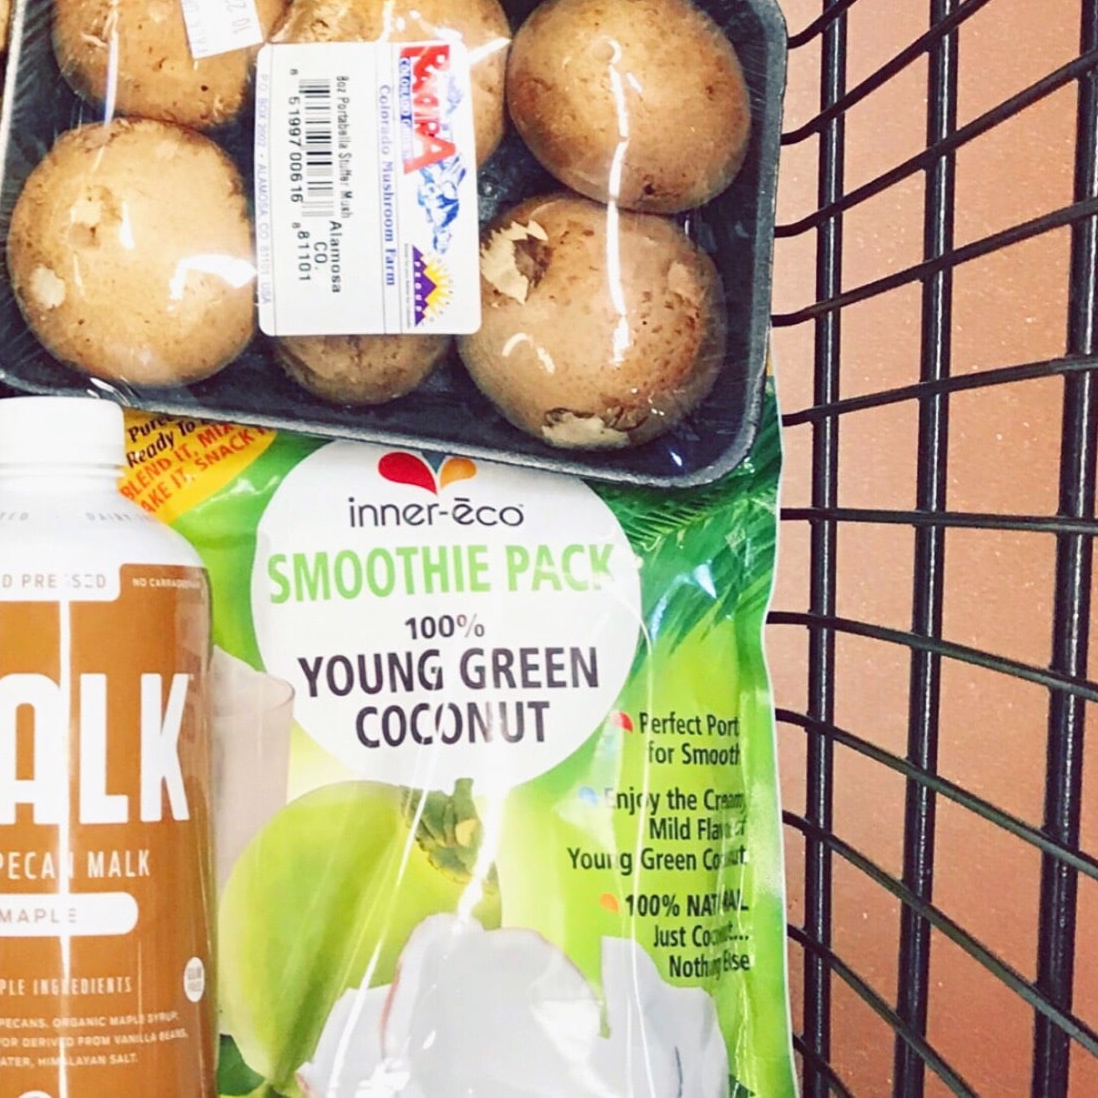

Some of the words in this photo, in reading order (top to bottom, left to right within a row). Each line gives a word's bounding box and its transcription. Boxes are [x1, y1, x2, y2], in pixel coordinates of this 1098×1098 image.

[336, 76, 349, 94] 8oz
[257, 97, 269, 118] BOX
[379, 84, 392, 156] Colorado
[337, 95, 351, 150] Portabella
[289, 151, 304, 203] 00616
[381, 159, 396, 243] Mushroom
[298, 230, 311, 282] 81101
[329, 220, 342, 293] Alamosa
[384, 249, 397, 287] Farm
[260, 280, 272, 306] USA
[414, 260, 423, 313] PROUD
[126, 430, 175, 468] Ready
[176, 419, 197, 437] To
[119, 457, 172, 501] BLEND
[139, 480, 173, 513] AKE
[193, 427, 256, 472] SNACK
[21, 573, 107, 589] PRESED
[132, 577, 147, 588] NO
[266, 541, 493, 606] SMOOTHIE
[504, 540, 616, 593] PACK
[404, 612, 486, 641] 100%
[297, 648, 445, 699] YOUNG
[459, 645, 601, 690] GREEN
[354, 699, 551, 749] COCONUT
[639, 711, 702, 736] Perfect
[648, 743, 676, 765] for
[604, 787, 661, 815] Enjoy
[666, 787, 698, 811] the
[649, 817, 691, 841] Mild
[87, 849, 151, 878] MALK
[567, 847, 633, 876] Young
[640, 848, 697, 871] Green
[625, 894, 680, 917] 100%
[653, 925, 687, 948] Just
[34, 976, 132, 995] INGREDIENTS
[53, 1016, 106, 1028] ORGANIC
[110, 1013, 145, 1026] MAPLE
[78, 1036, 111, 1047] FROM
[113, 1032, 156, 1045] VANILLA
